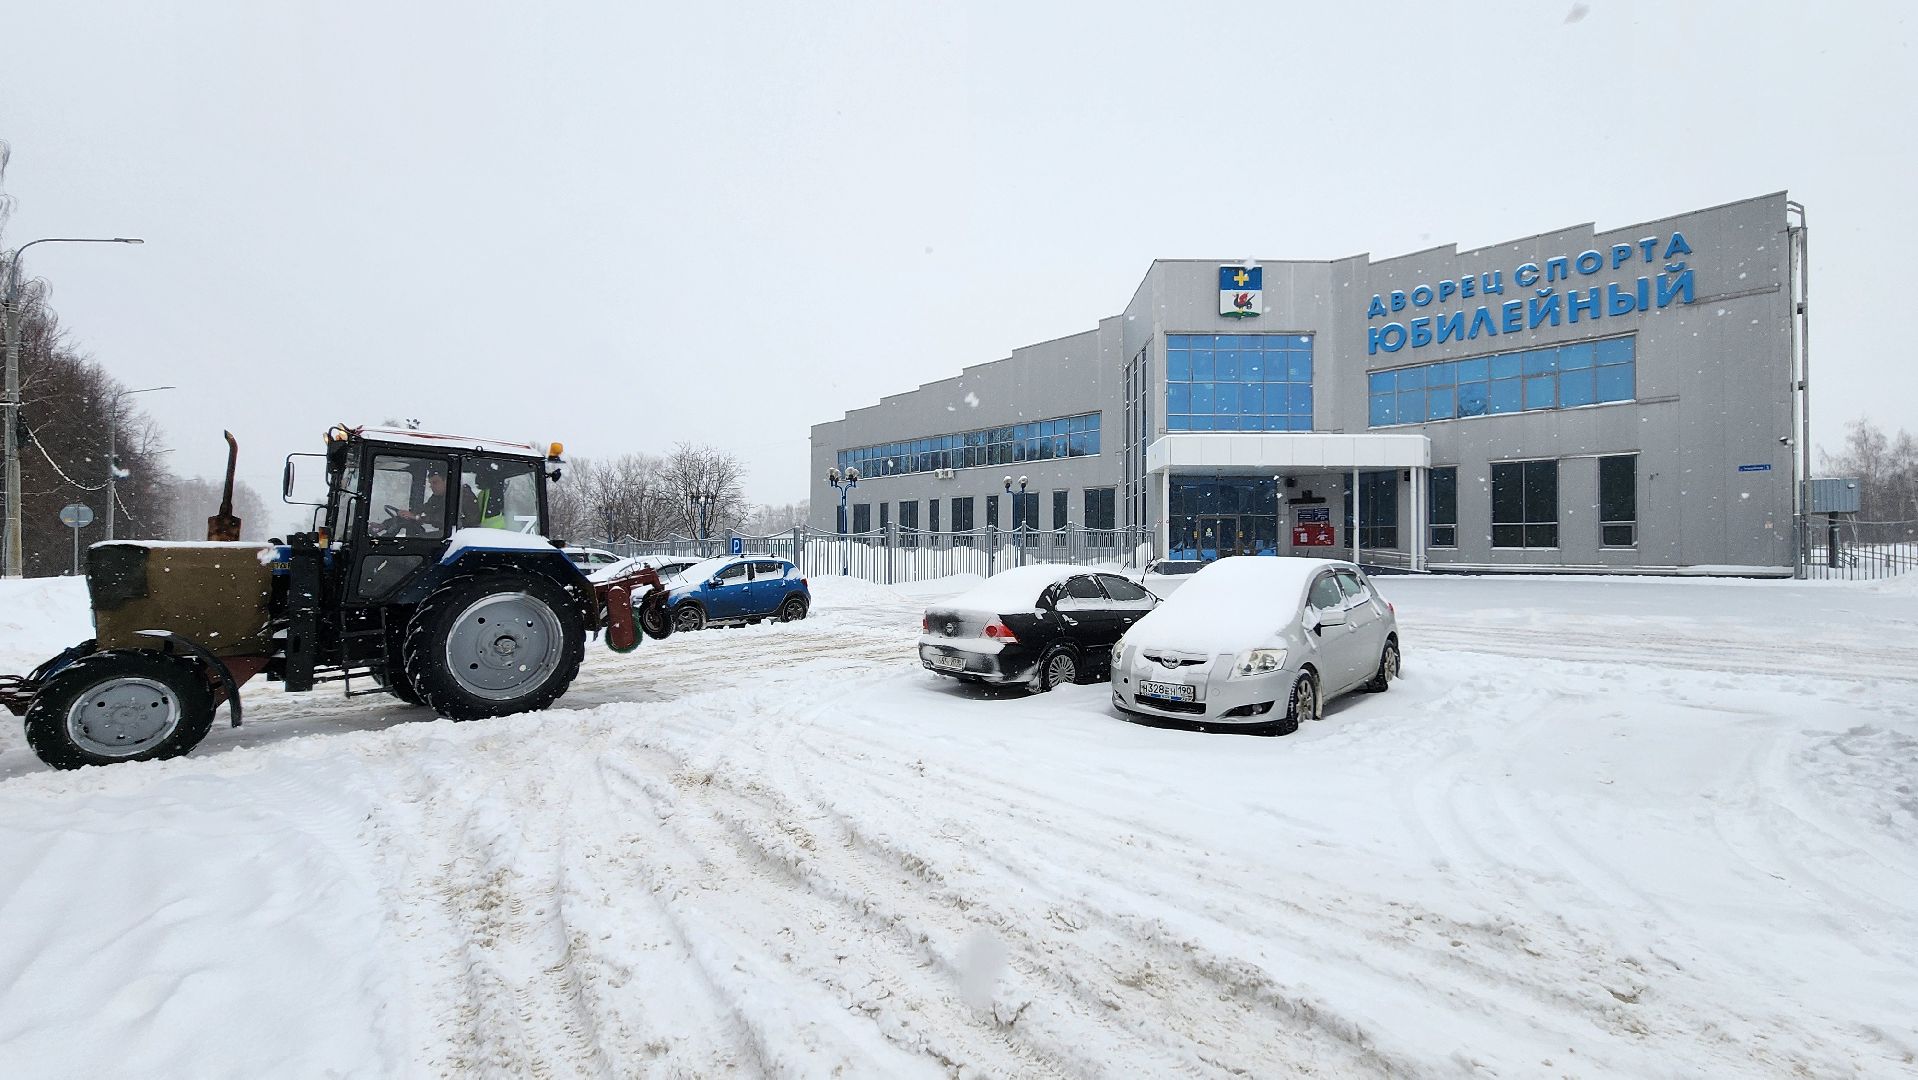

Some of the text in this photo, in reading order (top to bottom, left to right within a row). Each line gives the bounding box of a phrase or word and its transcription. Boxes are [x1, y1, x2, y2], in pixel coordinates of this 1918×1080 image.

[1367, 231, 1693, 319] ДВОРЕЦ СПОРТА
[1367, 260, 1696, 355] ЮБИЛЕЙНЫЙ
